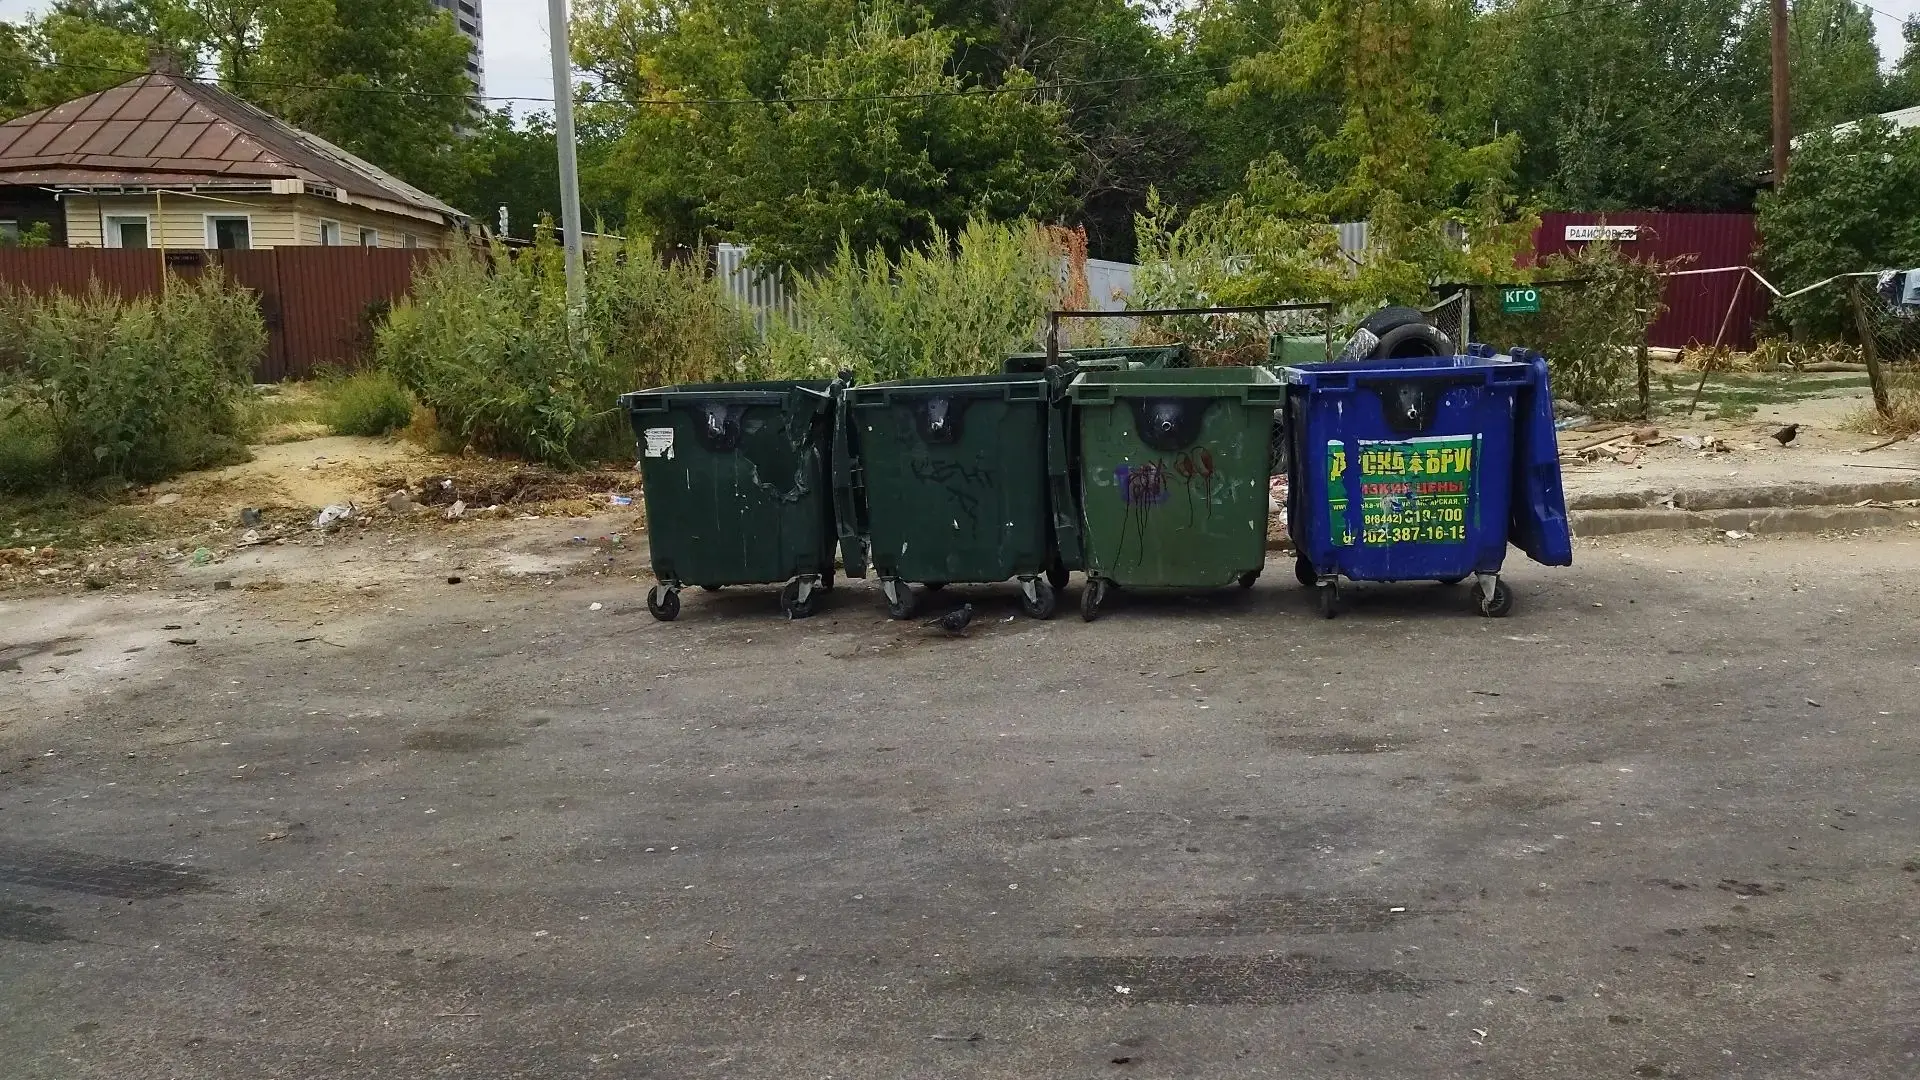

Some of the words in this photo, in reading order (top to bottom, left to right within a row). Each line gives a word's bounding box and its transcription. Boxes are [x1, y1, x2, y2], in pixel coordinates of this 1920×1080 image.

[1505, 290, 1536, 303] КГО
[1330, 451, 1405, 481] ДСКА
[1364, 513, 1402, 524] 8(8442)
